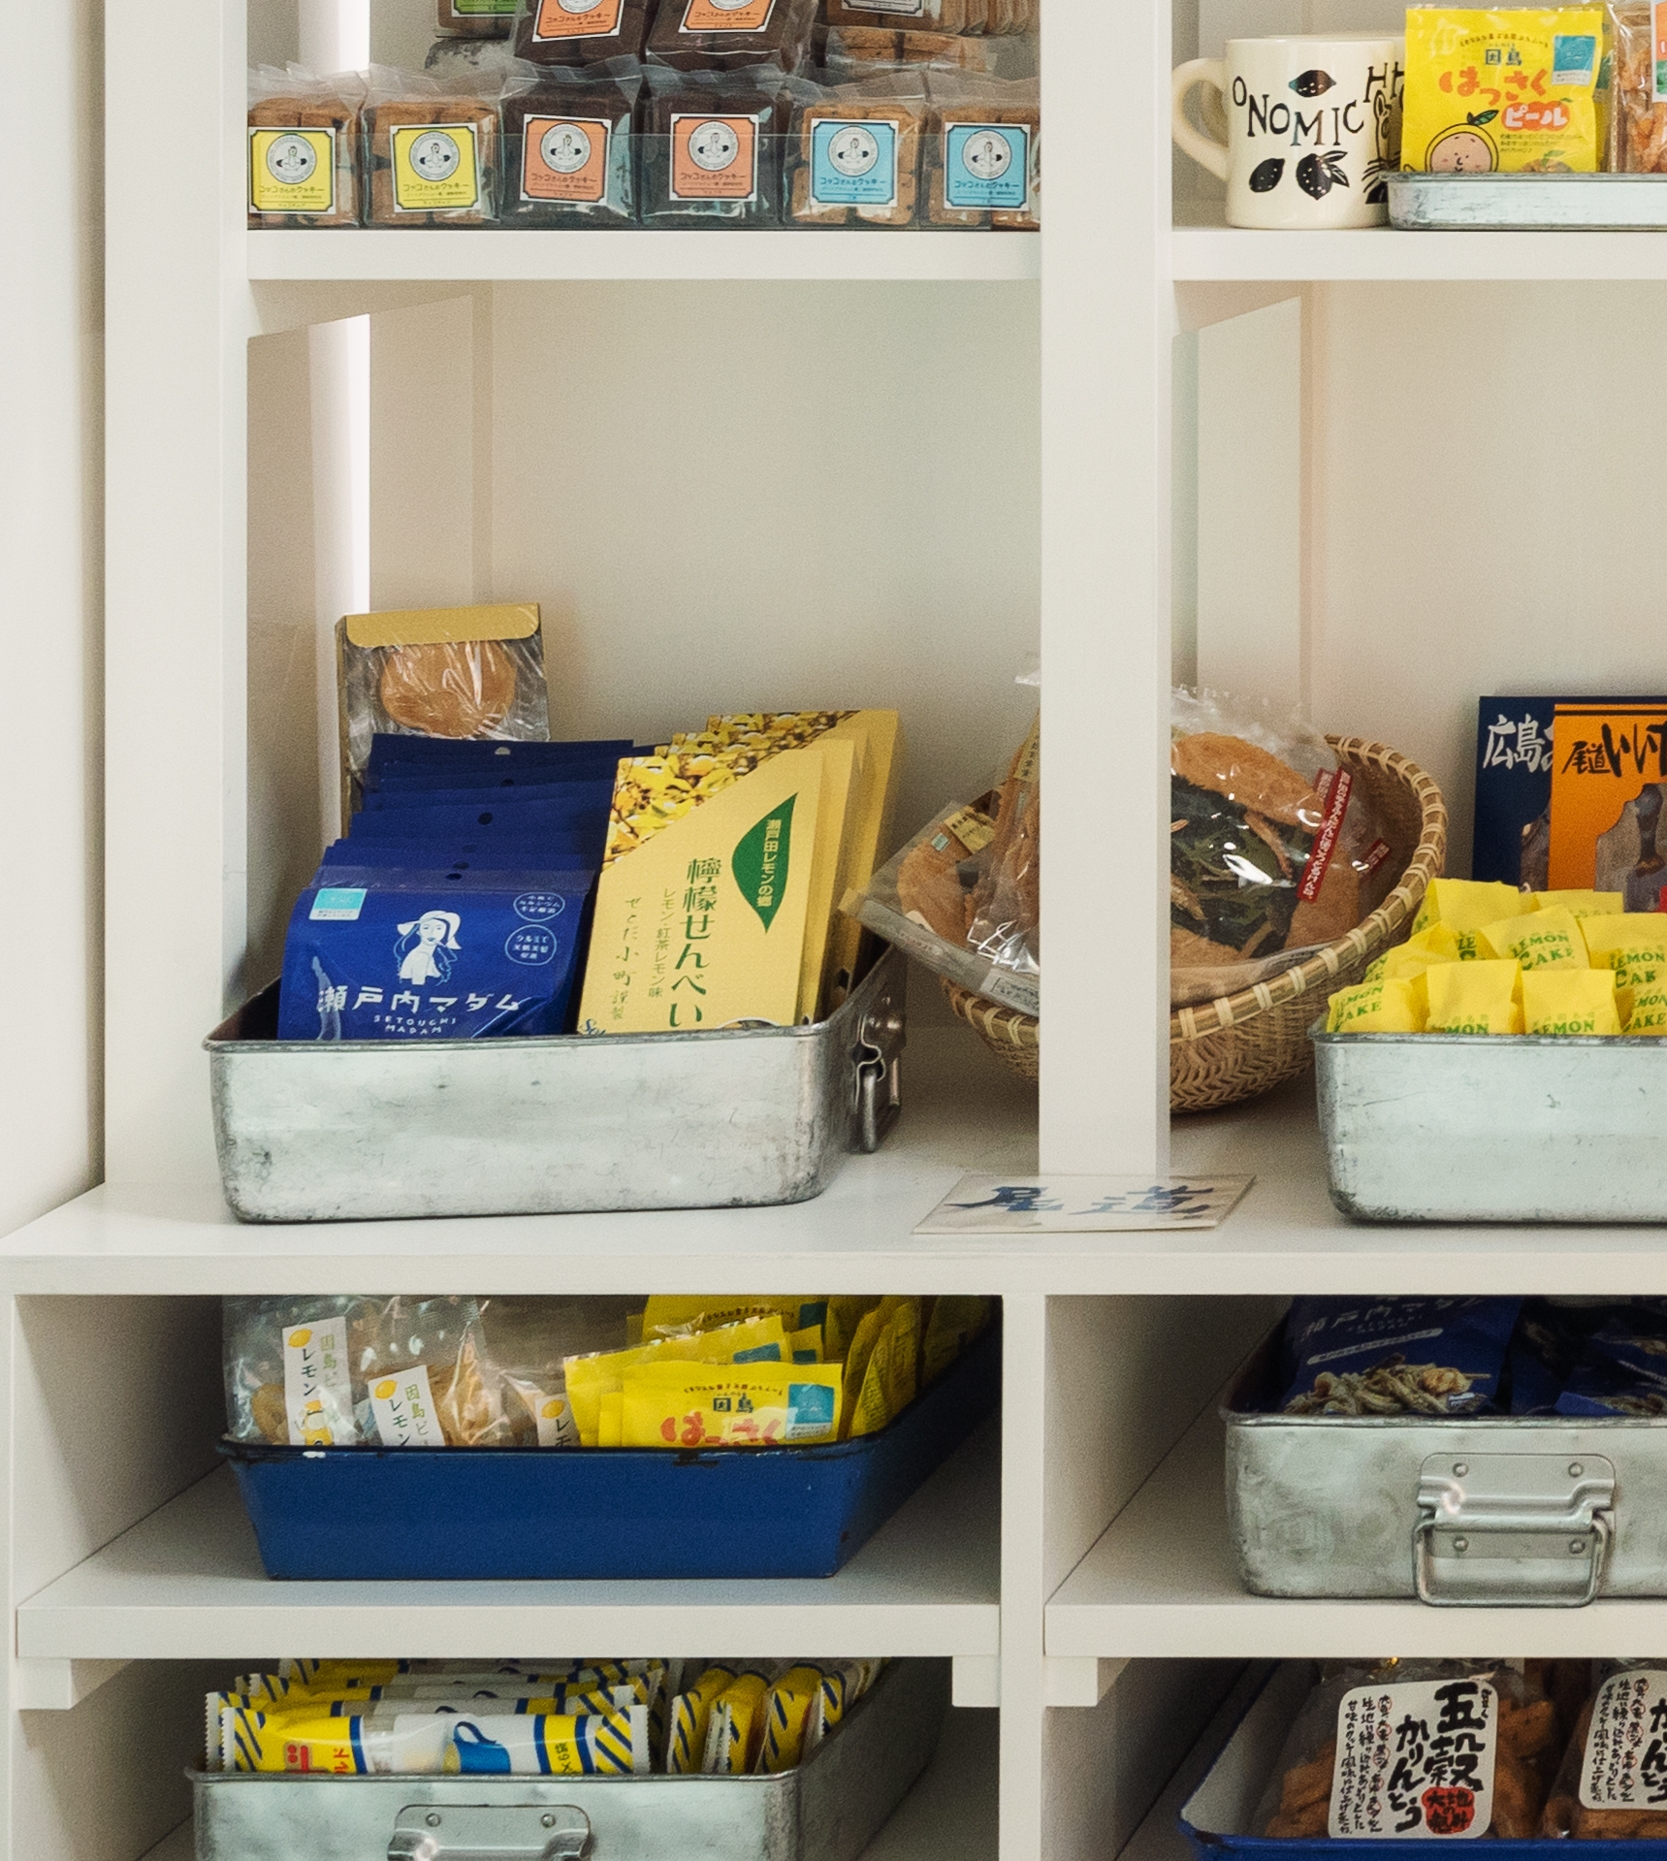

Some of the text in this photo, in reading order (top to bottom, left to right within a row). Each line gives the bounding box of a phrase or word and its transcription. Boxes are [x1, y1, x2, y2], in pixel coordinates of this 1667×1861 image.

[1486, 48, 1522, 66] 因島
[1439, 65, 1548, 107] はっさく
[1505, 104, 1568, 128] ピール
[756, 818, 783, 907] 瀬戸田レモンの郷
[669, 857, 722, 1027] 檸檬せんべい
[318, 985, 520, 1013] 瀬戸内マダム
[373, 1014, 457, 1025] SETOUCHI
[385, 1024, 442, 1034] MADAM
[301, 1348, 317, 1396] レモン
[389, 1399, 411, 1446] レモン
[713, 1393, 754, 1413] 因島
[1424, 1681, 1486, 1792] 五穀
[1386, 1714, 1430, 1833] かりんとう
